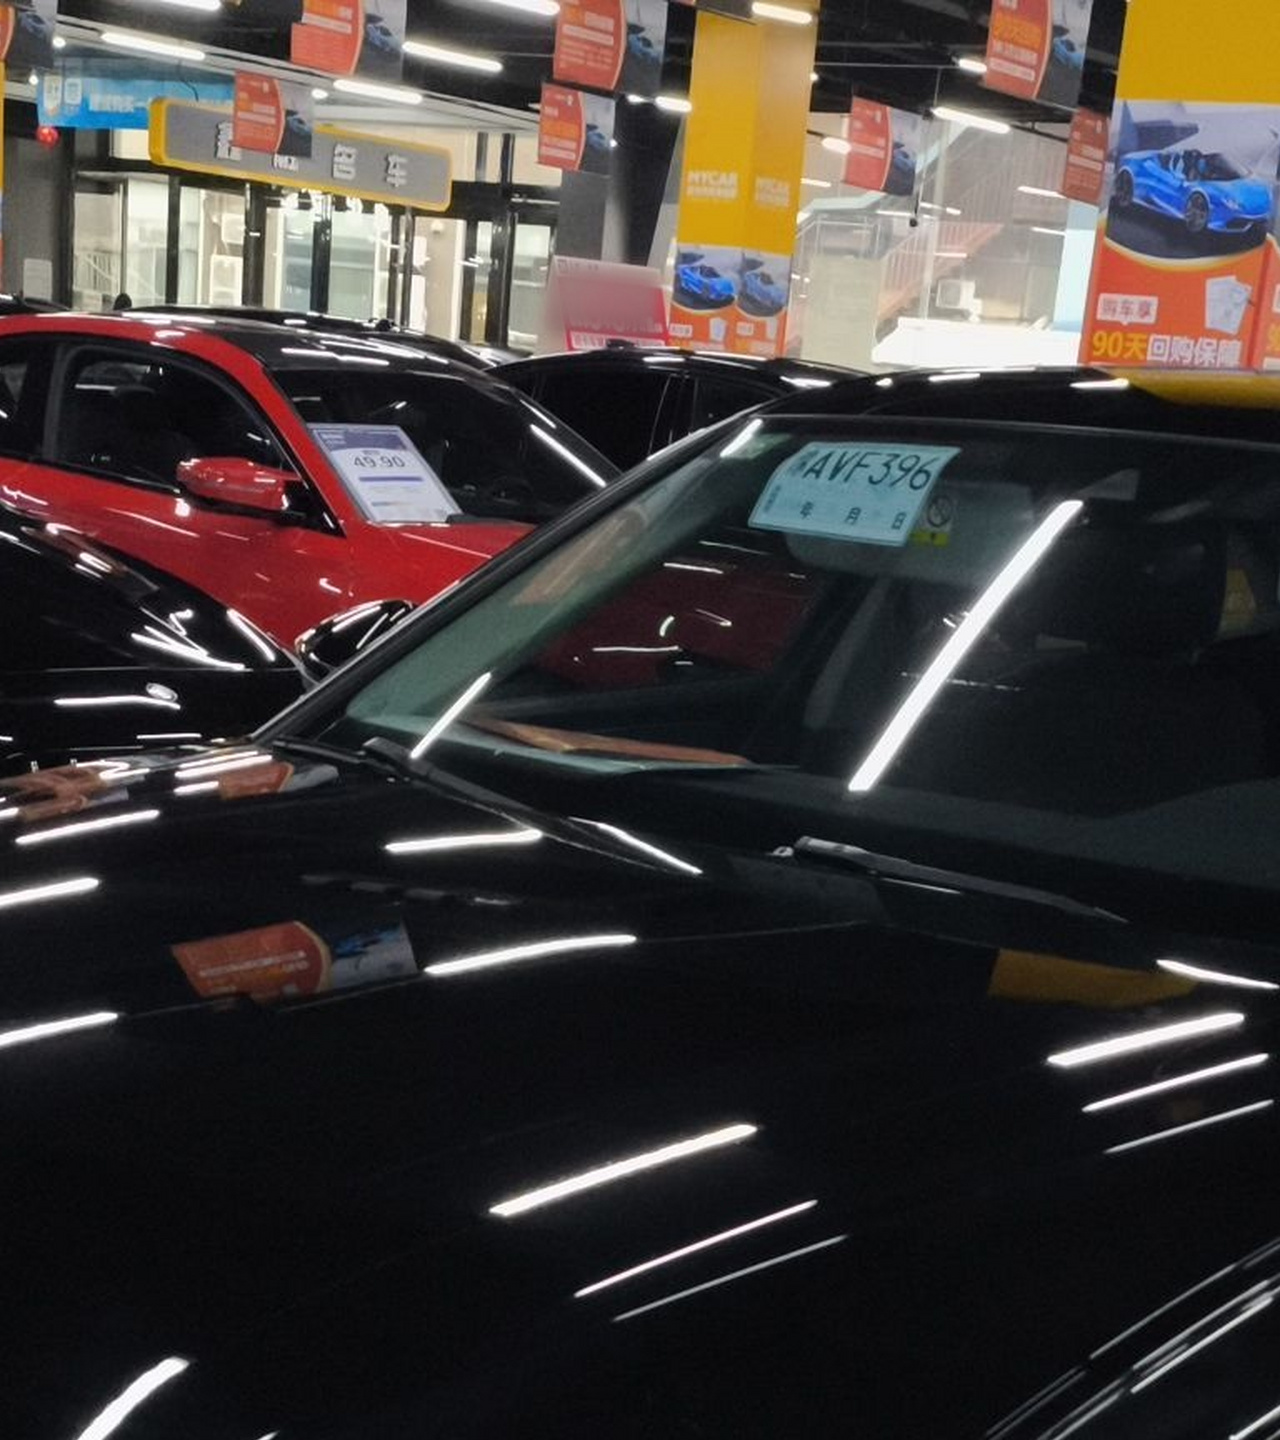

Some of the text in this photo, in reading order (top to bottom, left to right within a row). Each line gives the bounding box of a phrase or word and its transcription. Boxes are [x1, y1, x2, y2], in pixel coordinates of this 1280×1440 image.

[353, 455, 406, 468] 49.90
[789, 450, 941, 491] AVF396
[845, 506, 862, 526] 月
[891, 511, 908, 531] 日
